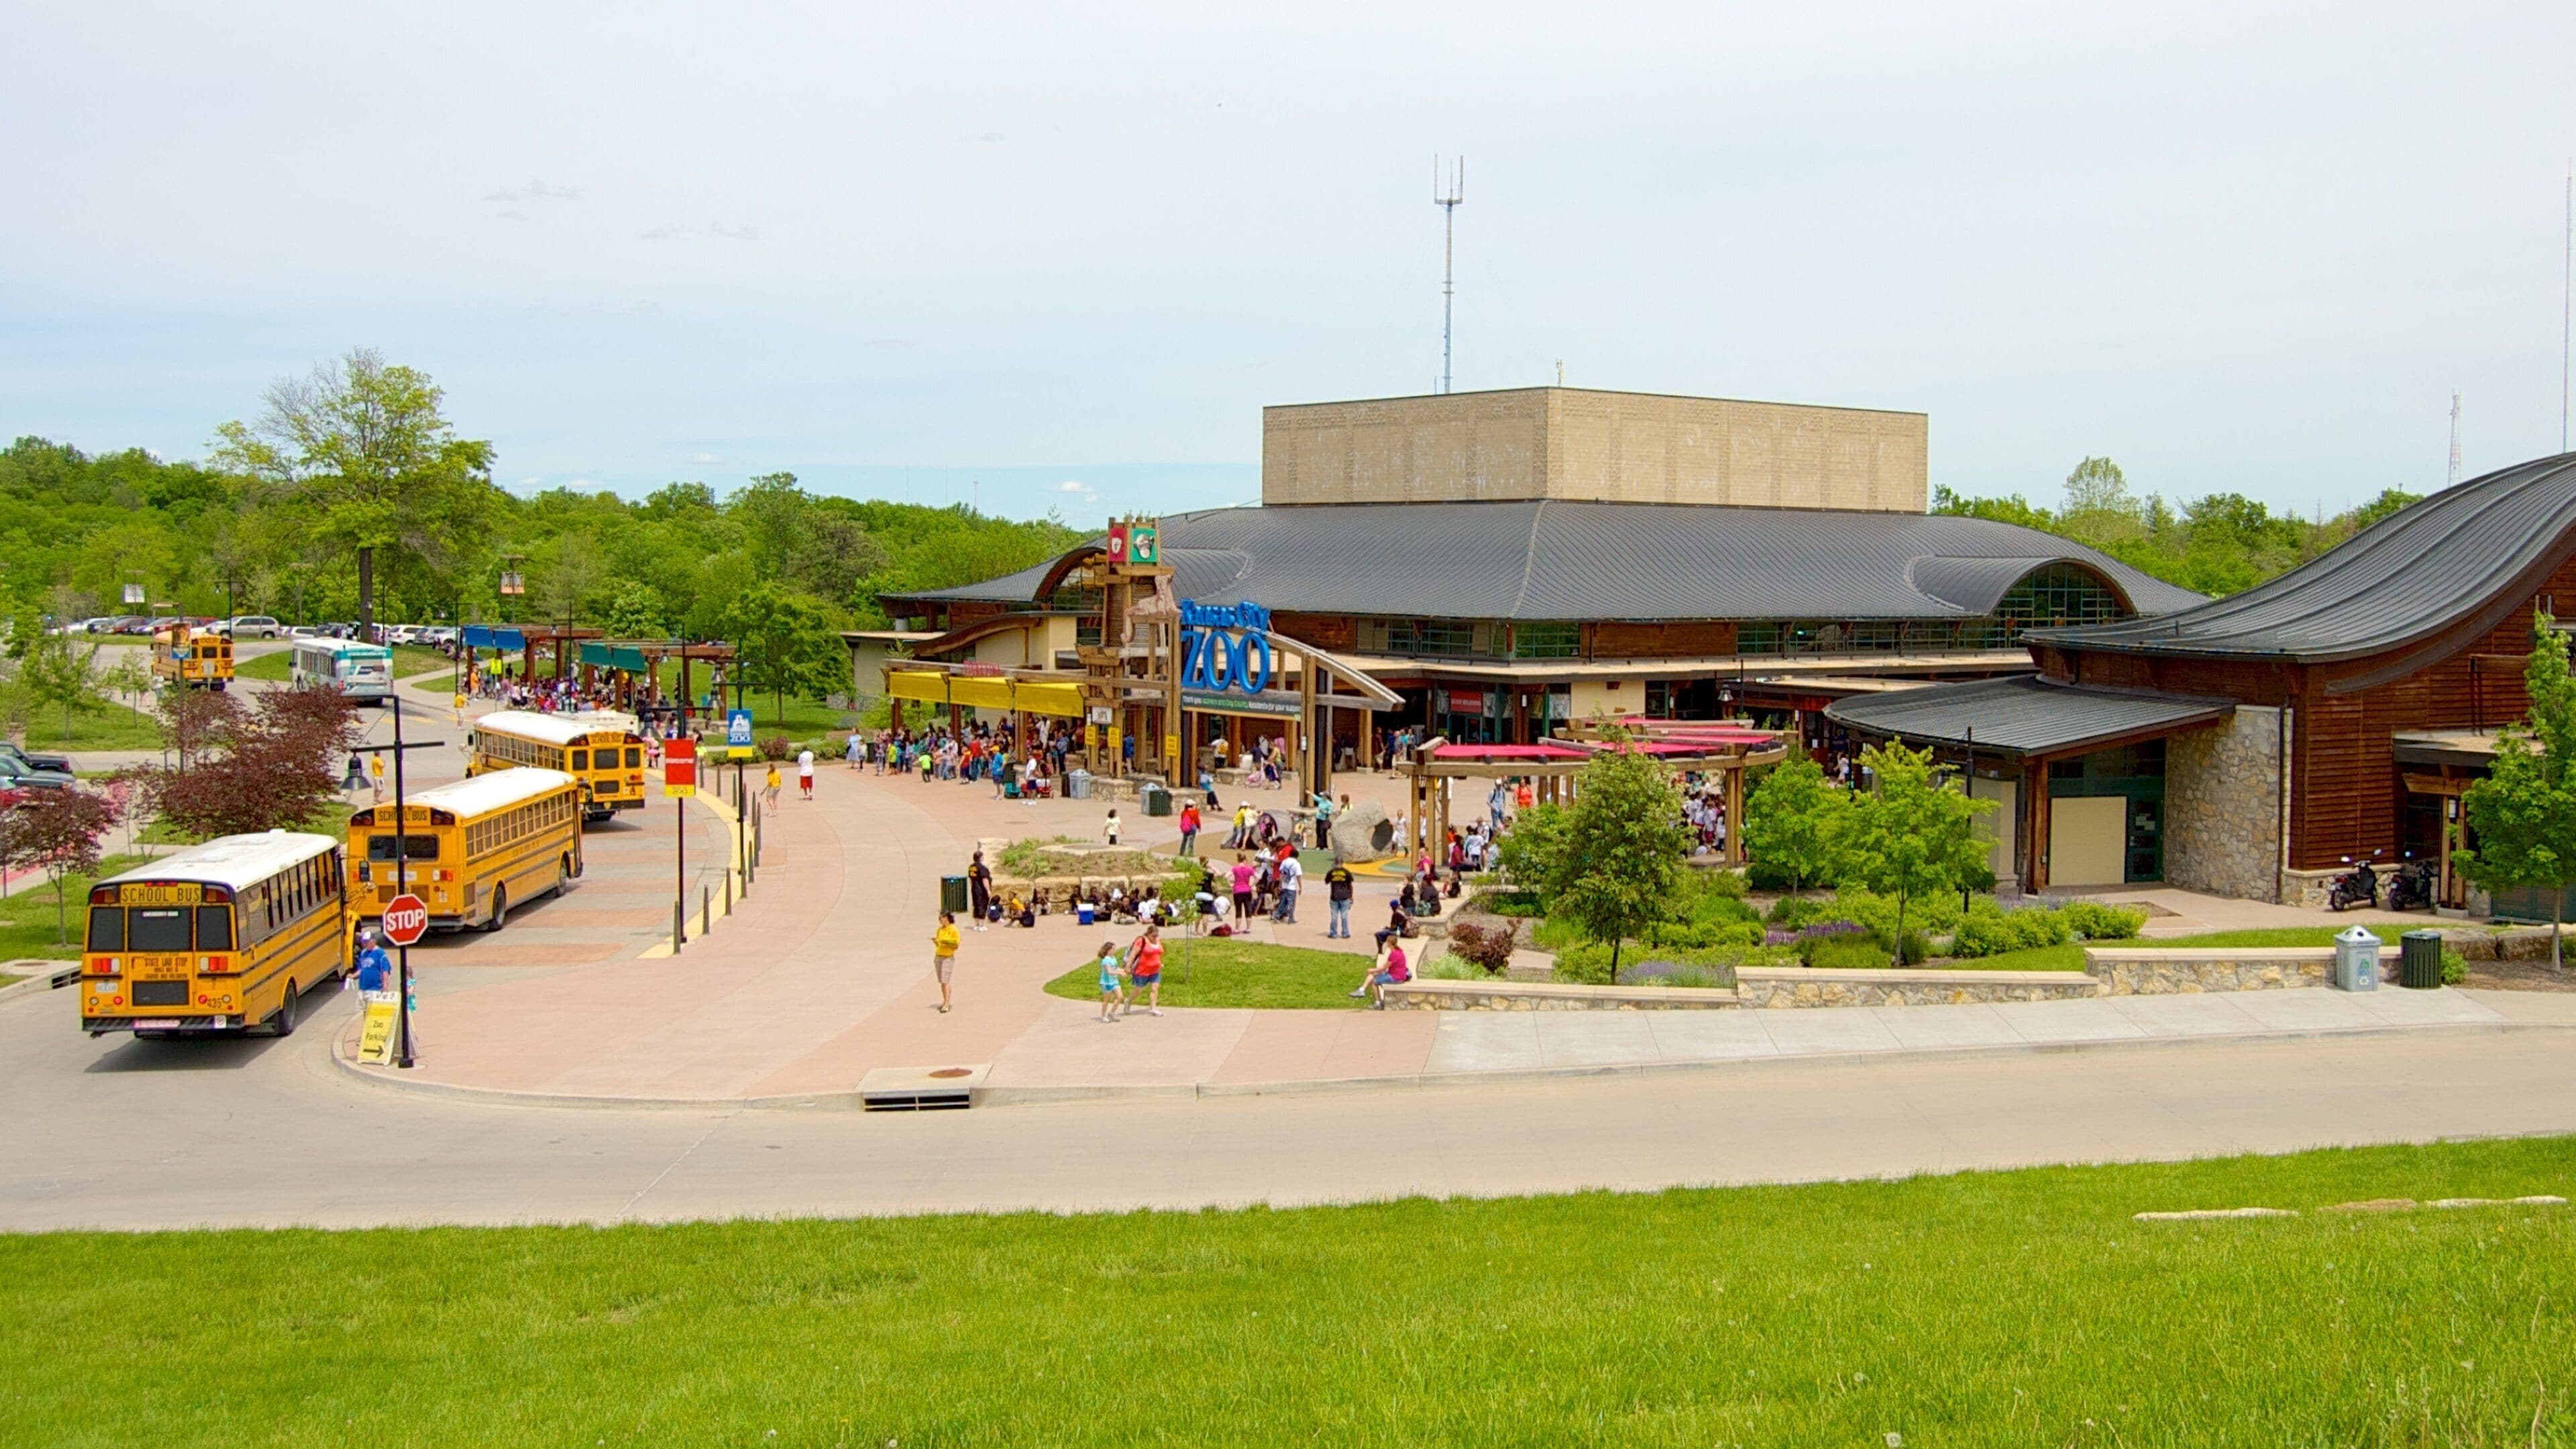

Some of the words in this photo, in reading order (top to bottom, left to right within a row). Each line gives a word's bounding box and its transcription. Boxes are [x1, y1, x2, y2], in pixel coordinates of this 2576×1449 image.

[1181, 630, 1270, 694] ZOO
[729, 735, 751, 743] ZOO
[378, 810, 410, 822] SCHOL
[413, 810, 427, 821] BUS
[122, 888, 168, 902] SCHOOL
[177, 888, 200, 902] BUS
[386, 908, 425, 932] STOP
